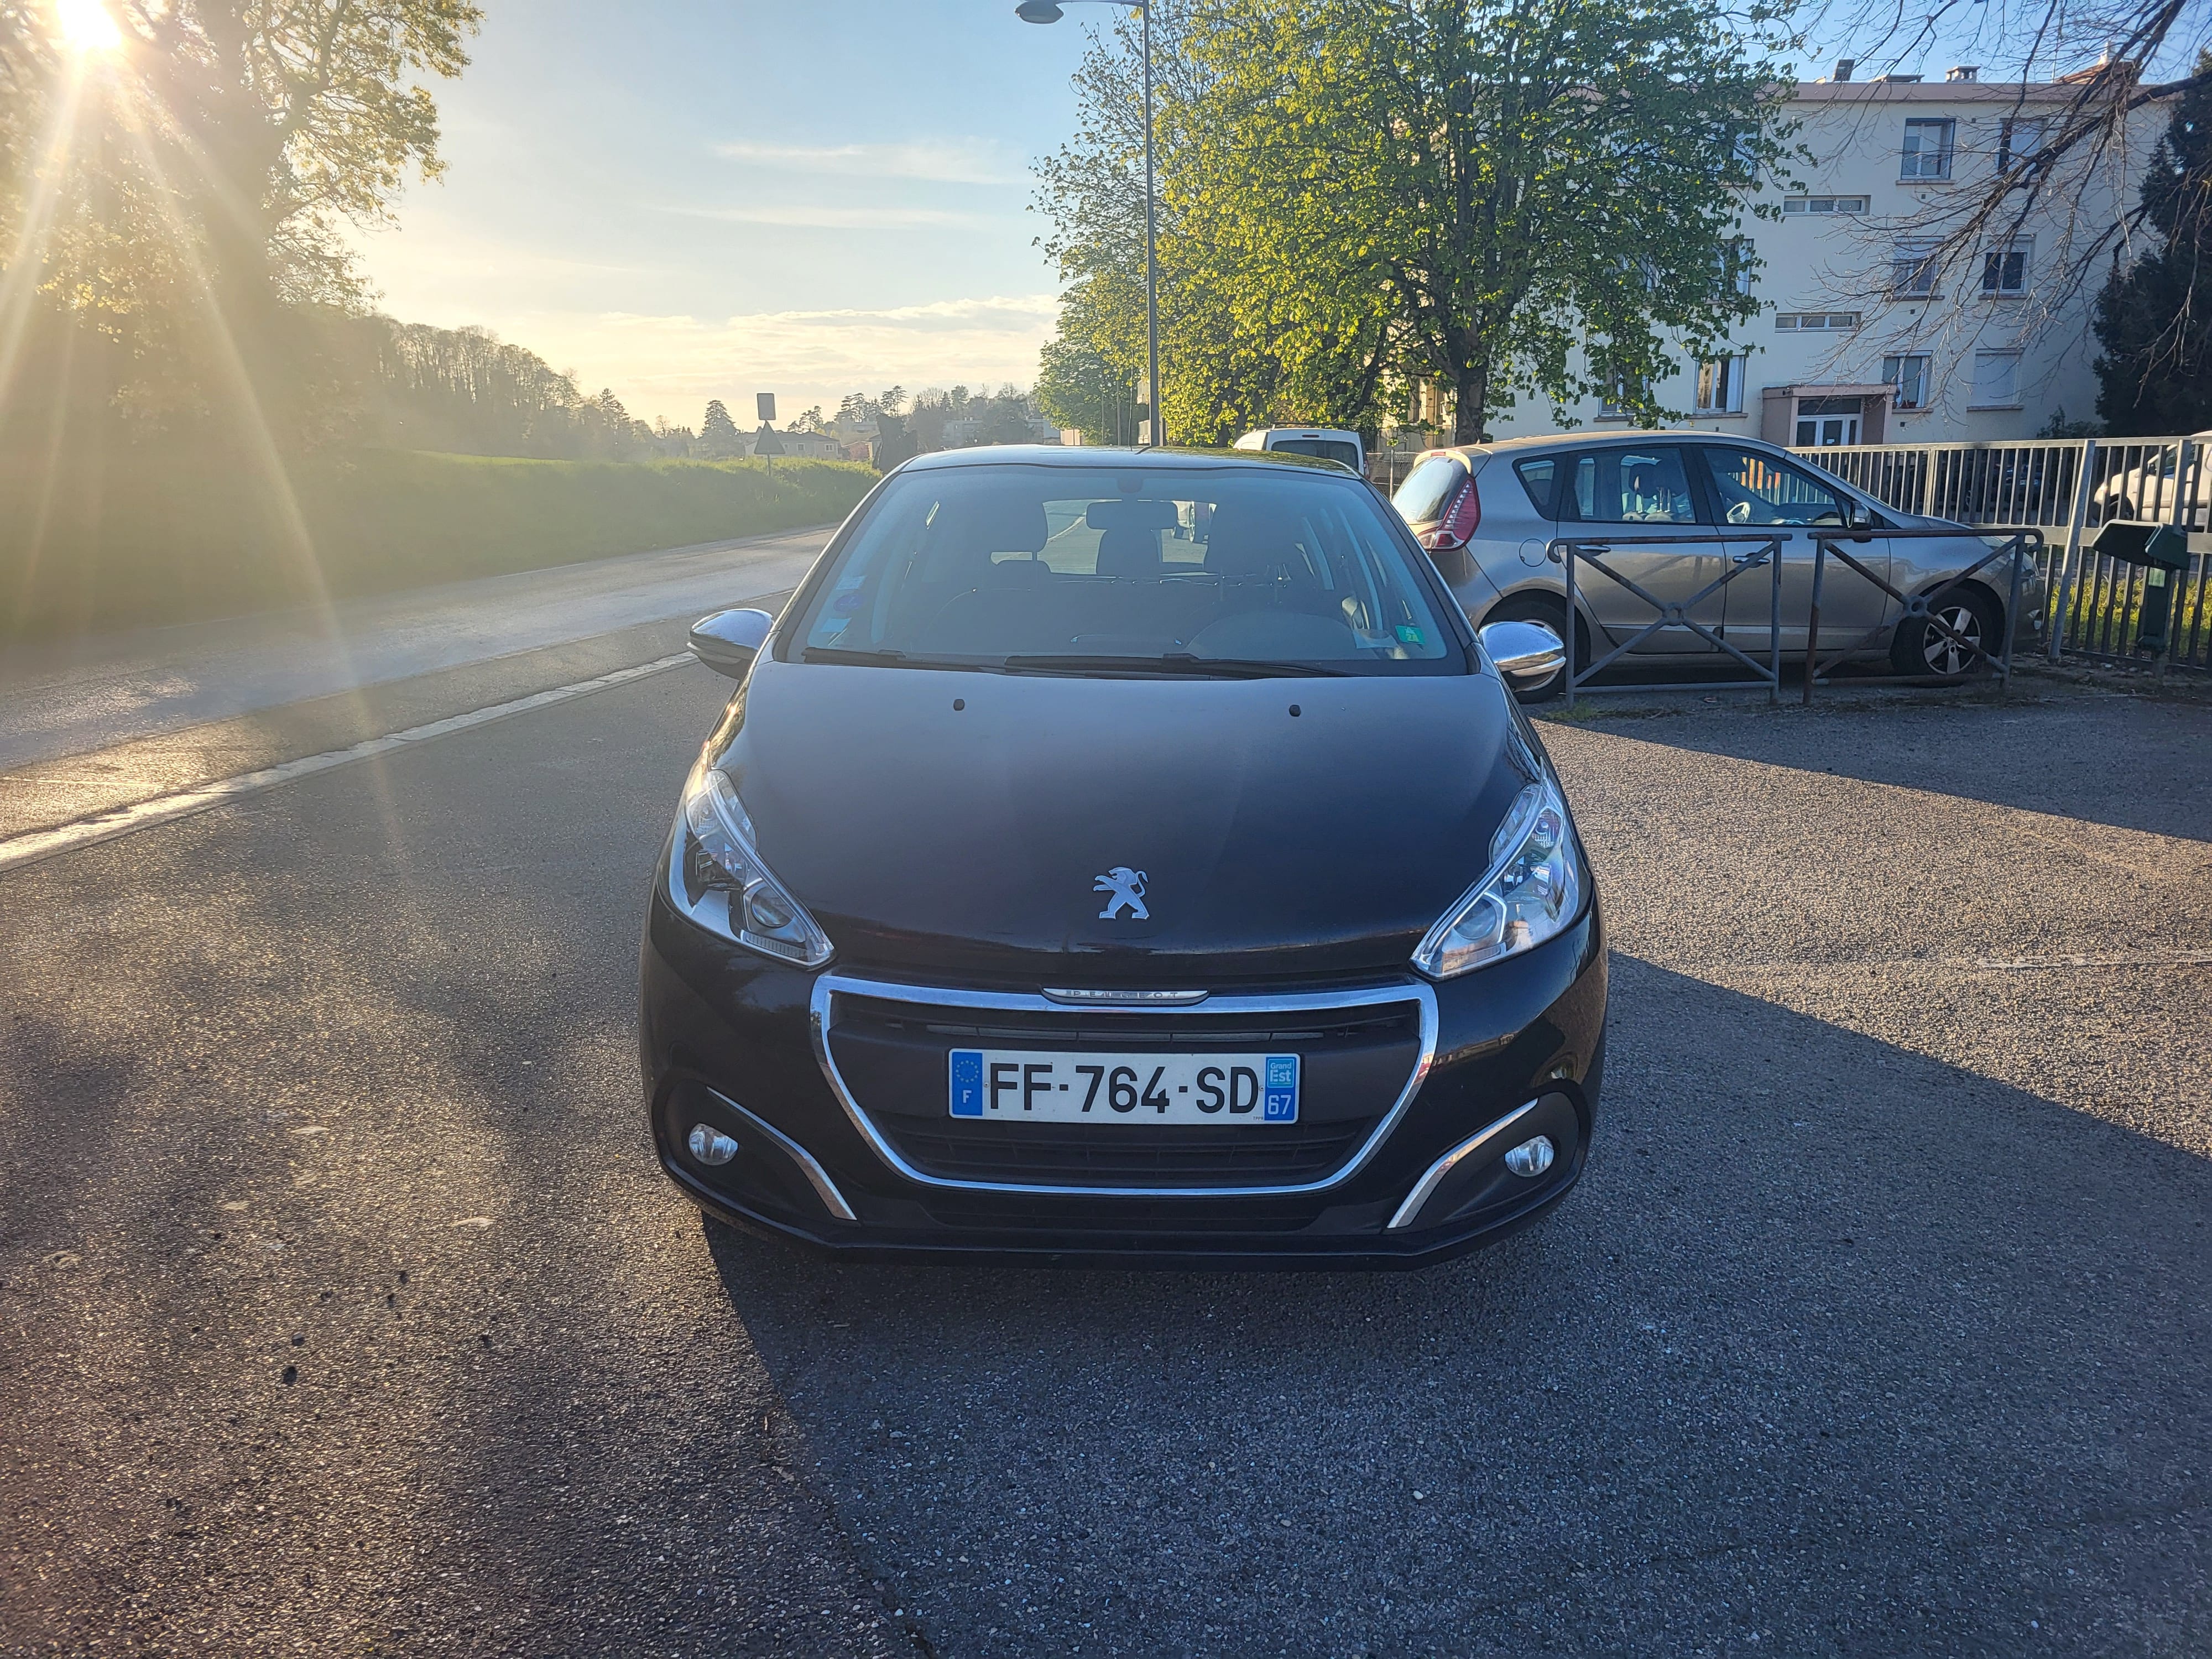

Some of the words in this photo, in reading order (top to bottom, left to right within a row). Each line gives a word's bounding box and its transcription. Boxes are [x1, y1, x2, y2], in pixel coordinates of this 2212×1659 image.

[1270, 1070, 1291, 1082] Est
[963, 1090, 972, 1103] F
[990, 1063, 1259, 1113] FF-764-SD
[1267, 1094, 1291, 1115] 67
